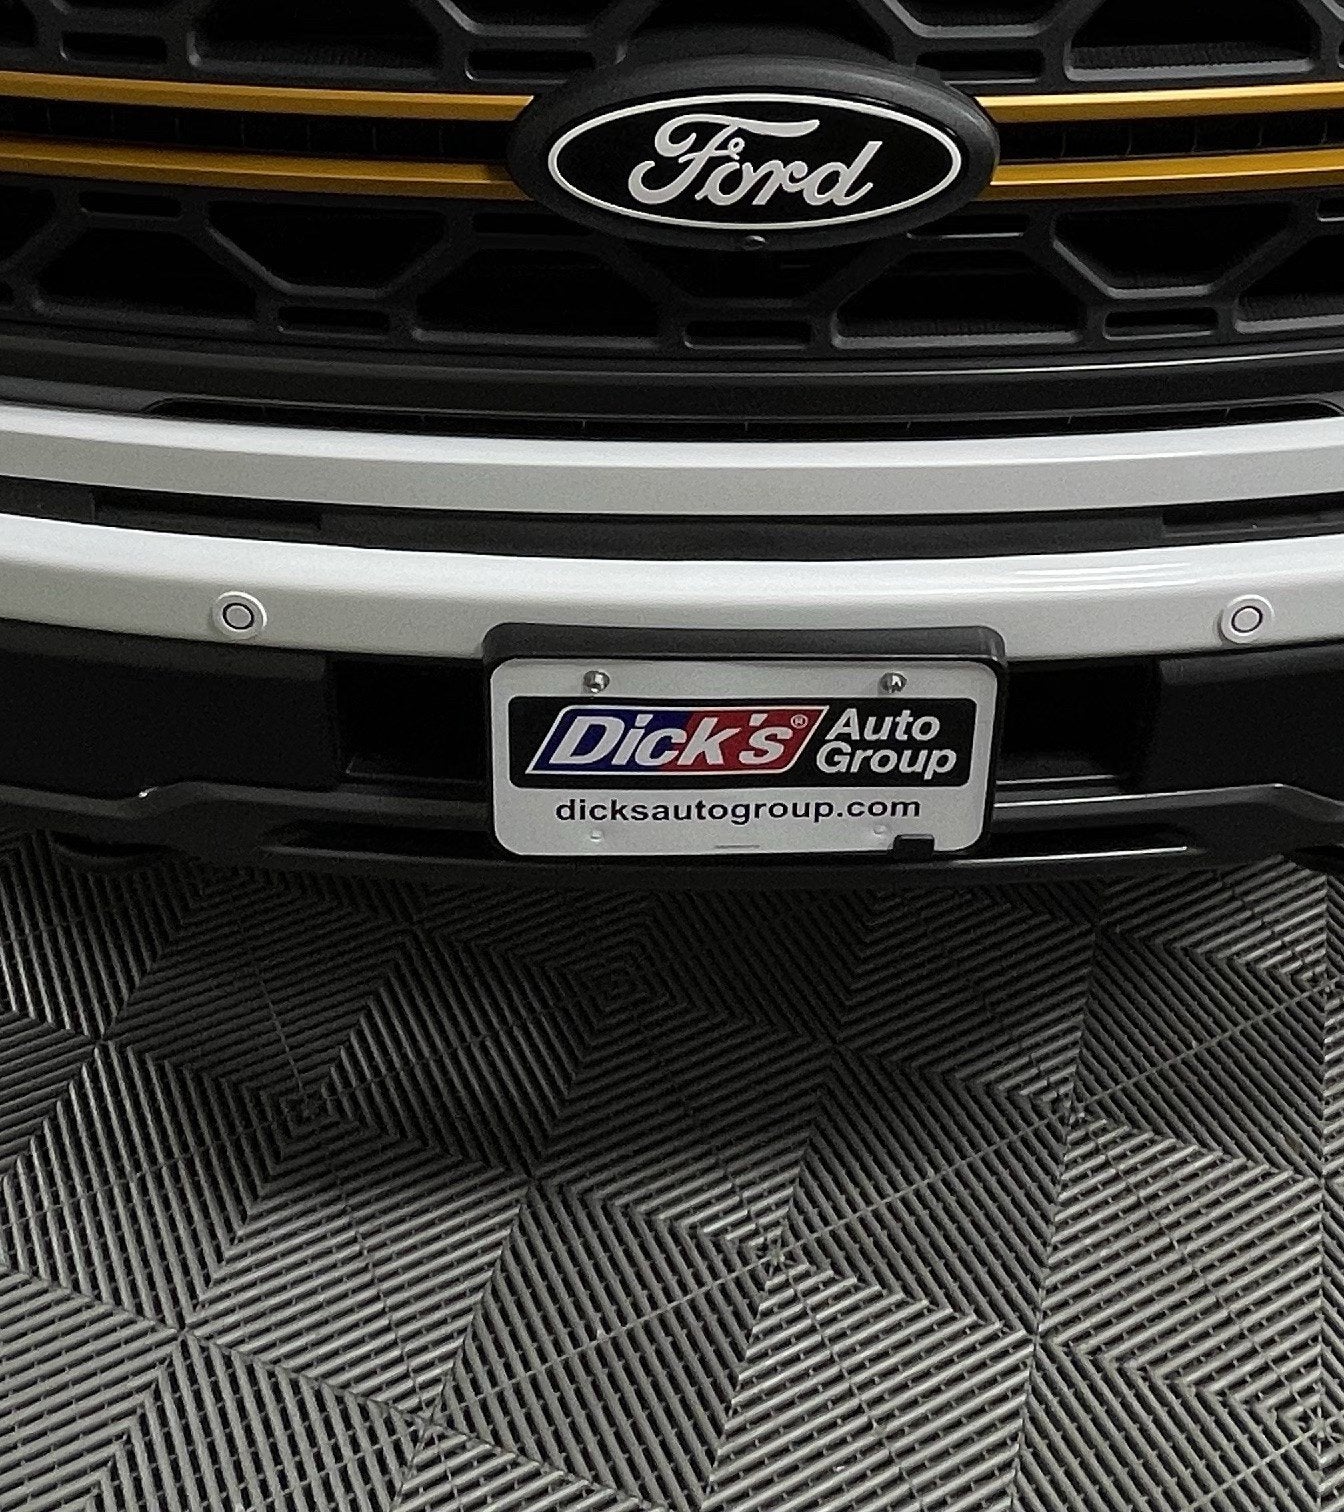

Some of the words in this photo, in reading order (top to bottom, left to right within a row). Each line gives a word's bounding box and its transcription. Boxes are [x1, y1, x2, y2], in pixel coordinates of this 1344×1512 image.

[627, 113, 883, 207] Ford
[824, 708, 941, 741] Auto
[816, 740, 957, 780] Group
[555, 798, 921, 825] dicksautogroup.com
